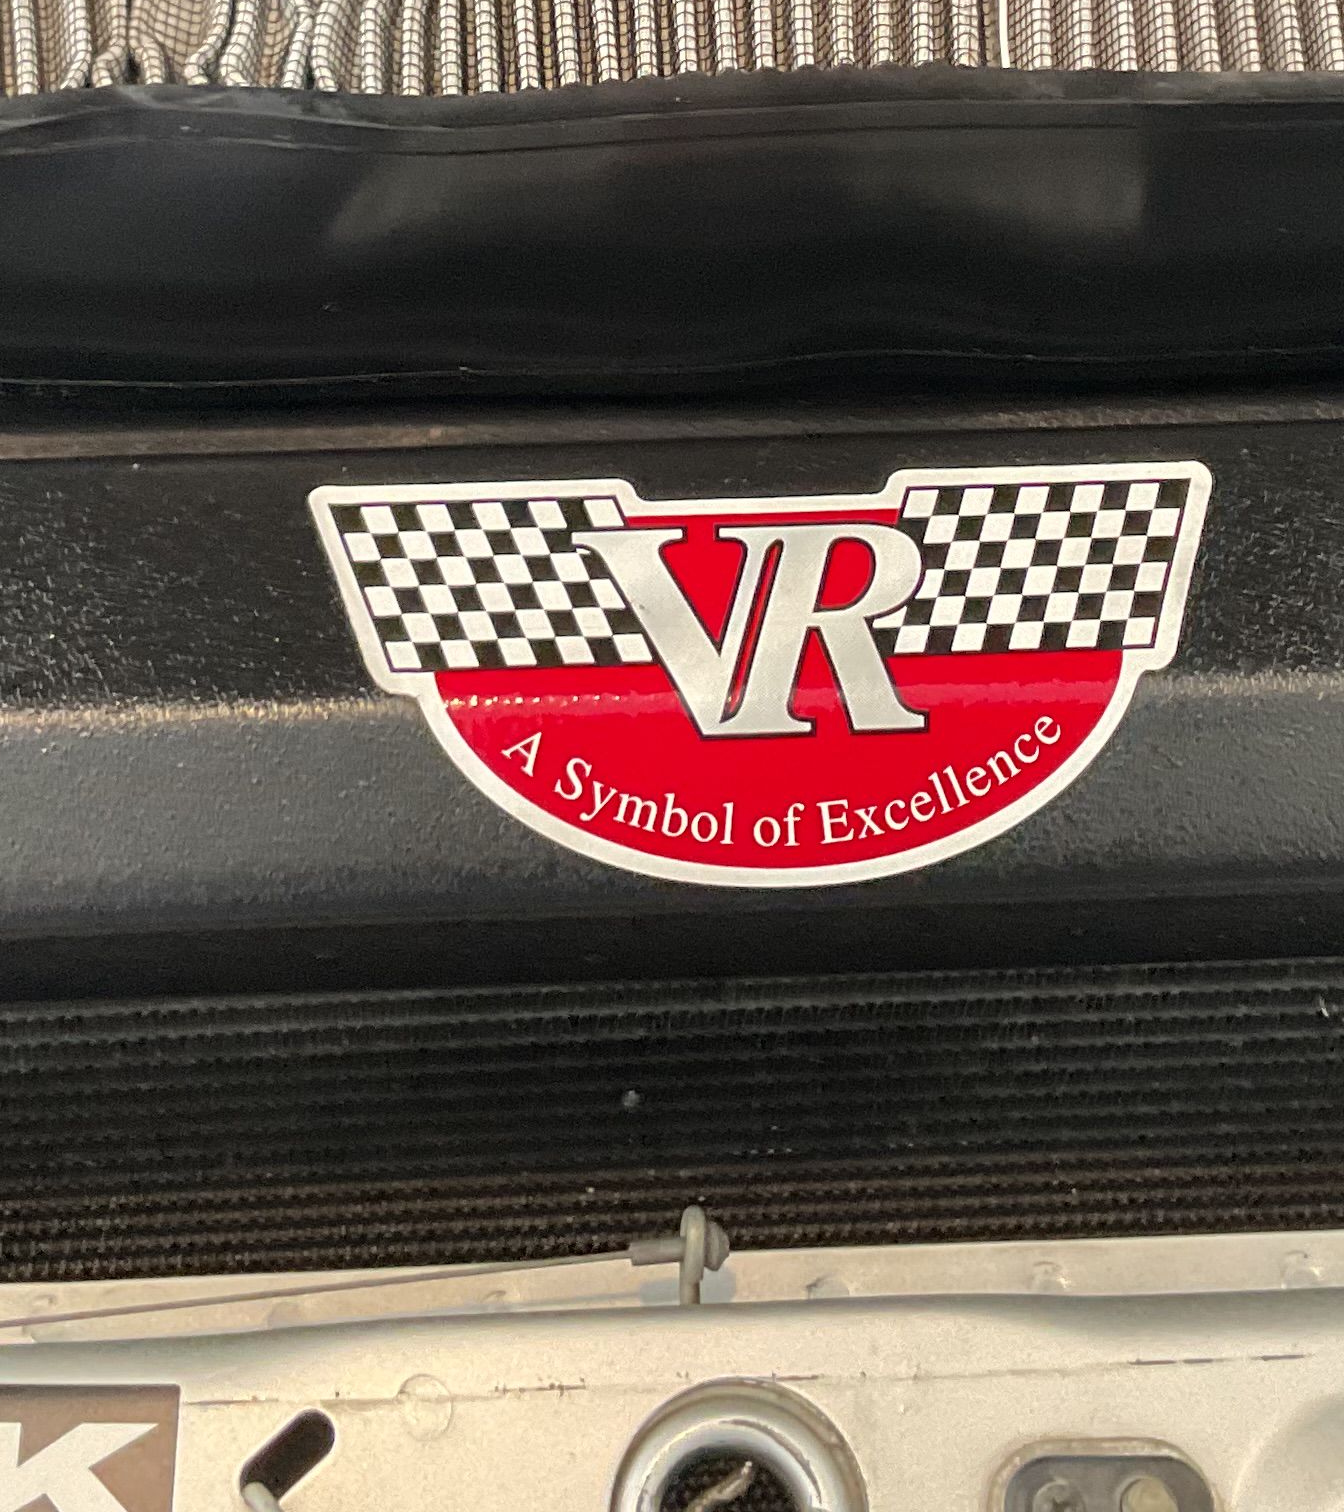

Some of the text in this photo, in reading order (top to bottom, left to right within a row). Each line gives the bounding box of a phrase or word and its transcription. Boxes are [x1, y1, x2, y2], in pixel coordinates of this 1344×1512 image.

[572, 522, 929, 738] VR
[502, 710, 1063, 848] A Symbol of Excellence
